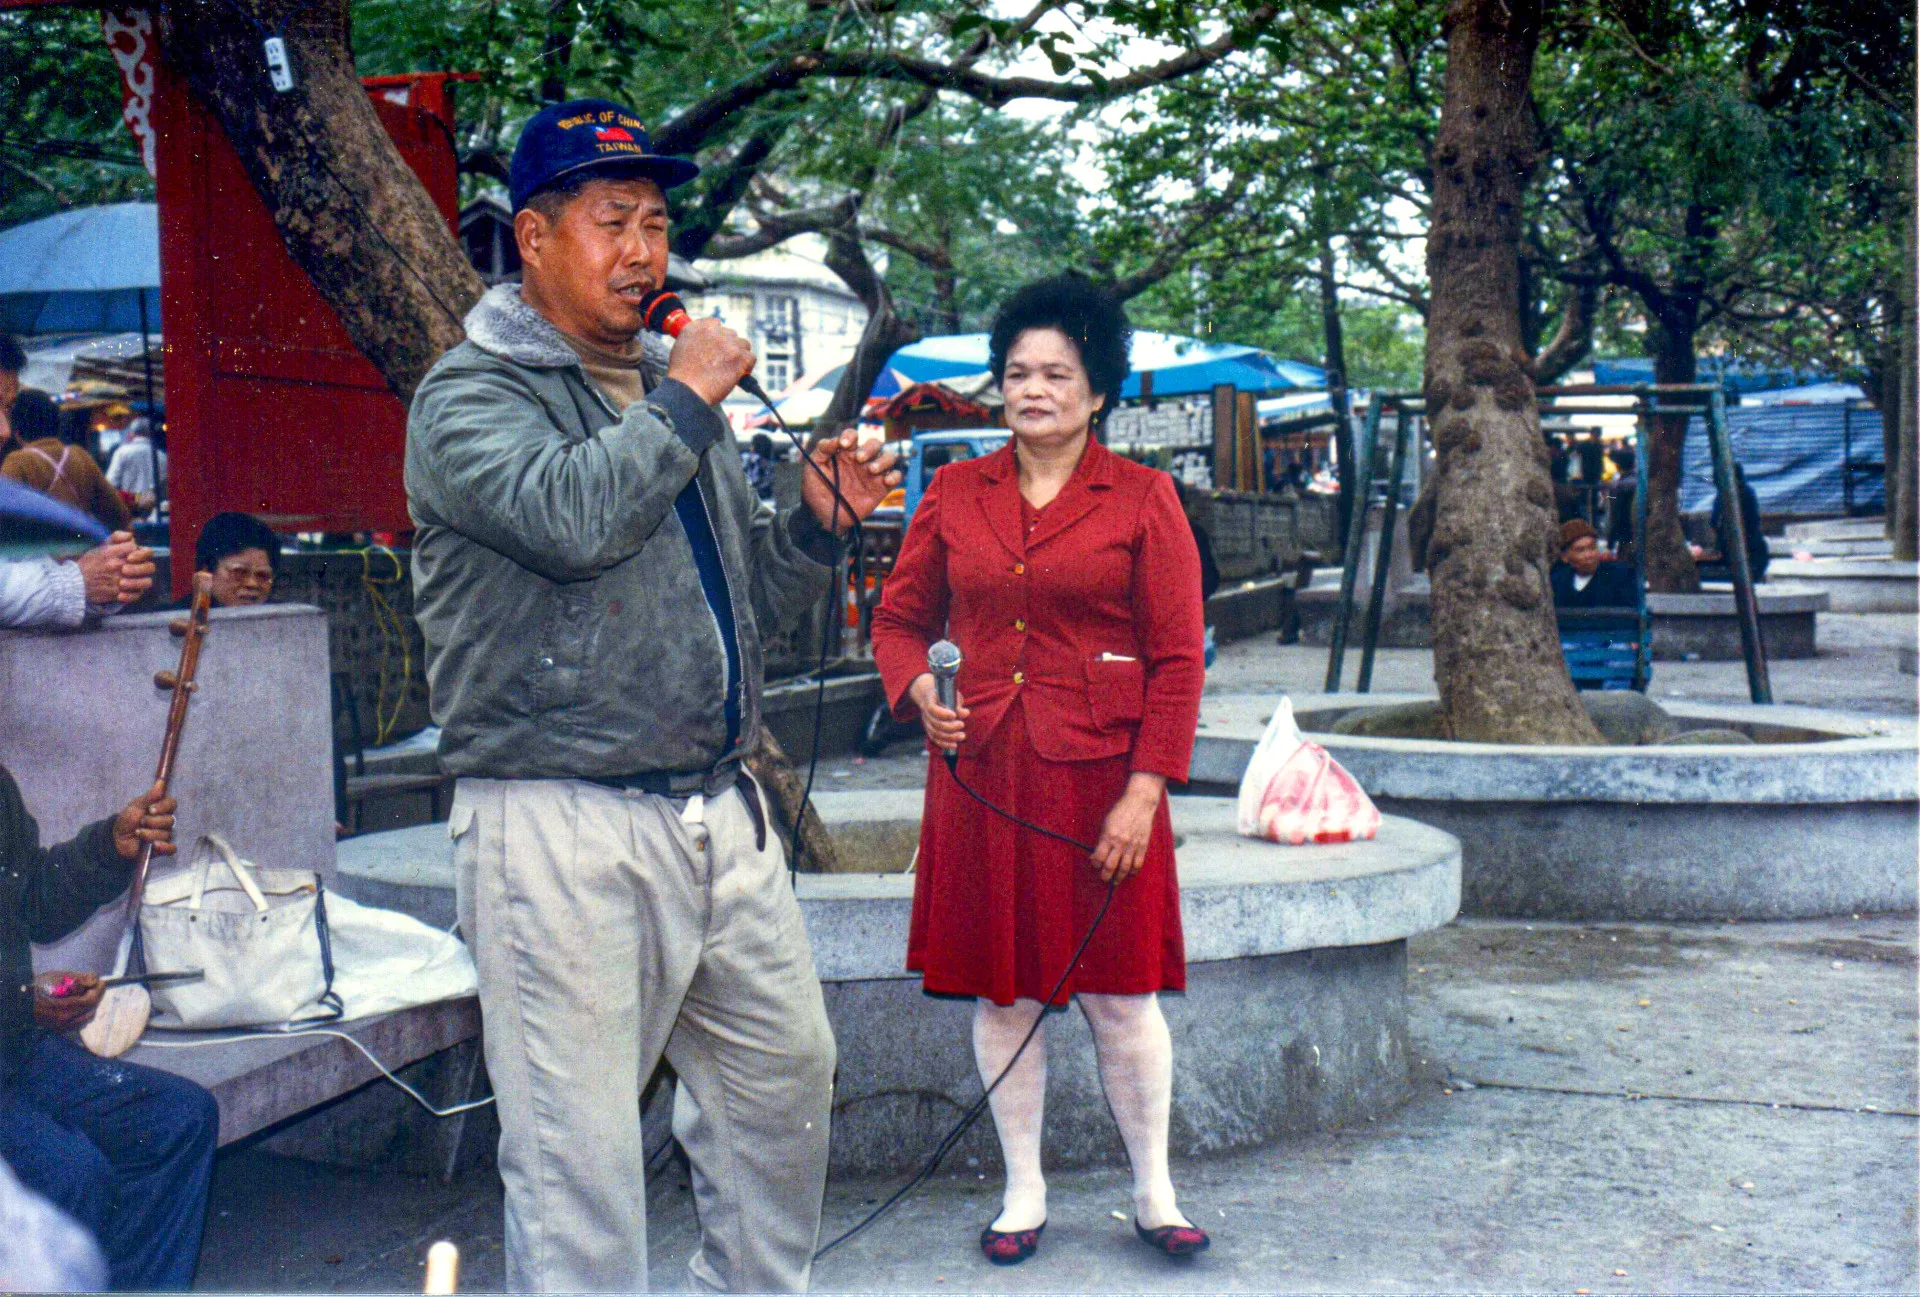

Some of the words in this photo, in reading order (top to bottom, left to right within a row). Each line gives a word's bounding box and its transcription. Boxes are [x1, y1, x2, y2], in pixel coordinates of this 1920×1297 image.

[599, 110, 614, 123] OF
[618, 113, 646, 132] CHINA
[596, 141, 642, 154] TAIWAN
